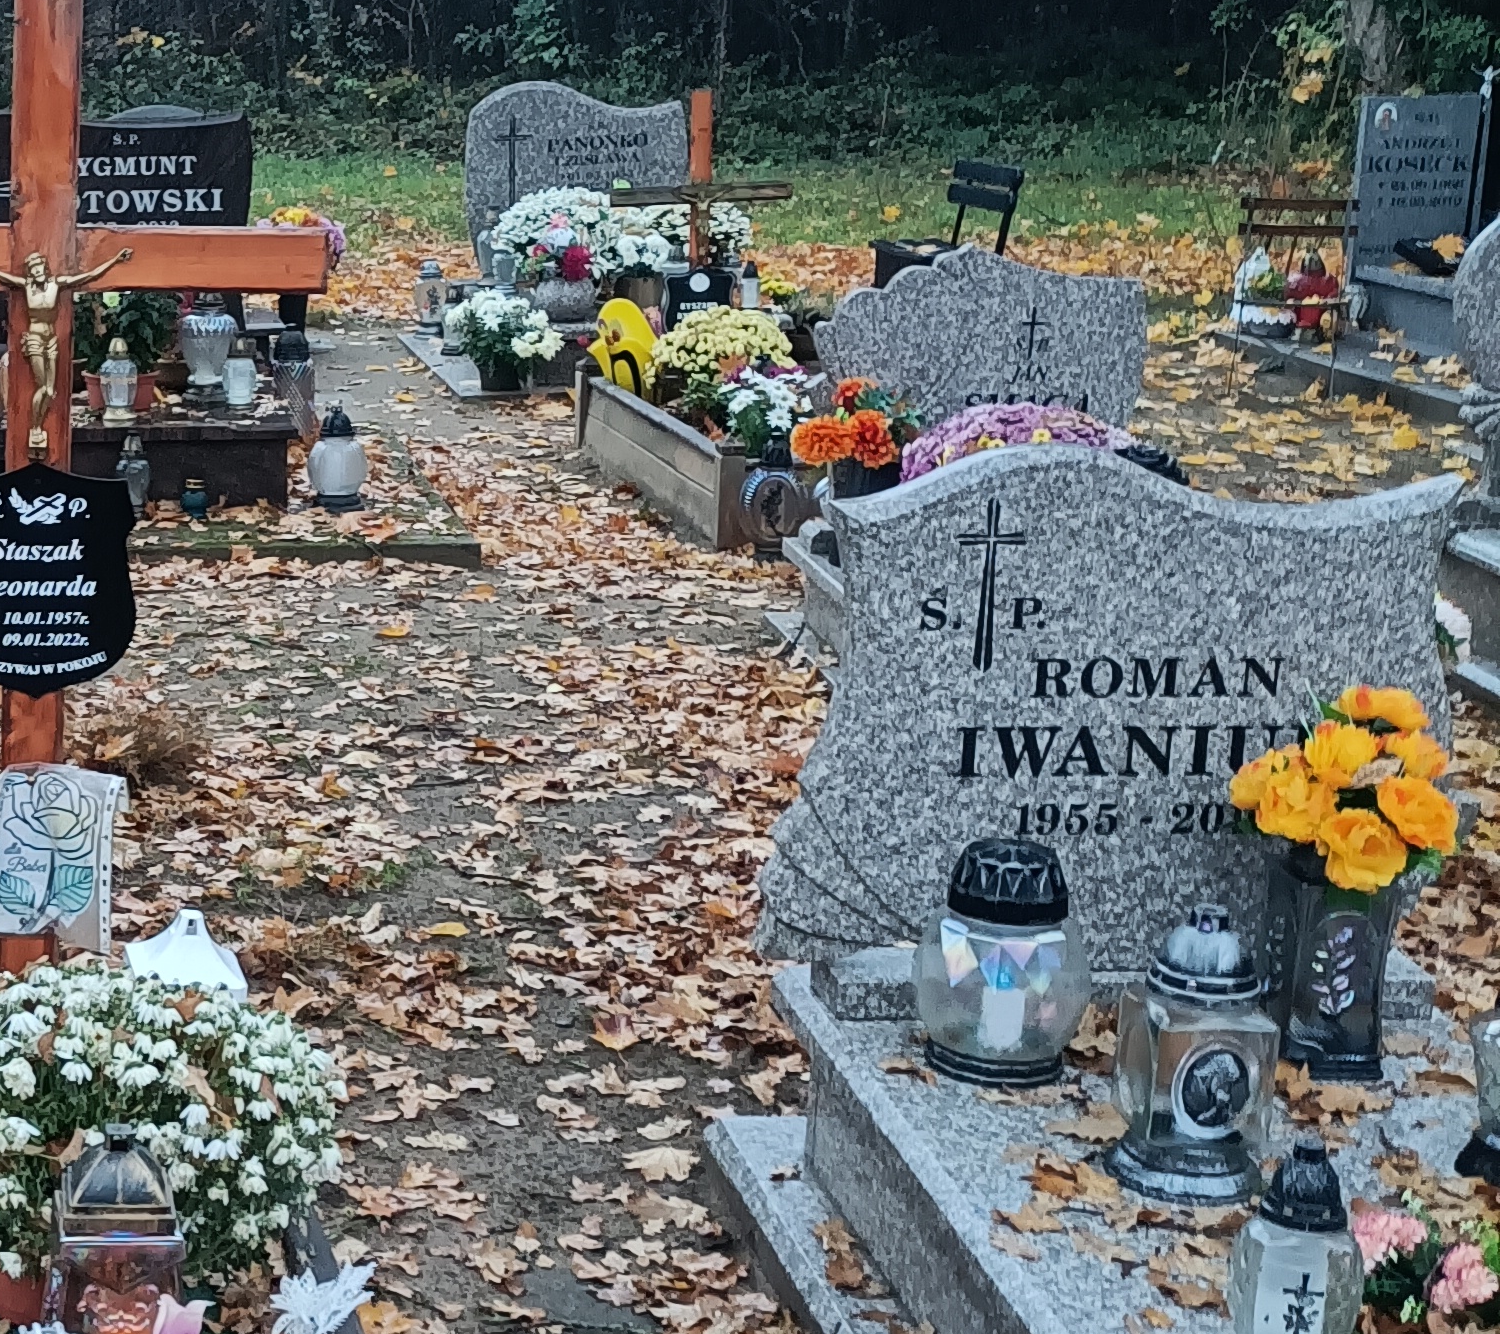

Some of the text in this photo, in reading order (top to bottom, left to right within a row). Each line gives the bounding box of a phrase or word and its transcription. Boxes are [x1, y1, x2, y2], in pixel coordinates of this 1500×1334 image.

[77, 155, 198, 177] YGMUNT
[76, 188, 224, 214] TOWSKI
[68, 497, 91, 519] P.
[2, 611, 90, 625] 10.01.1957r.
[1010, 597, 1046, 629] P.
[1, 632, 90, 647] 09.01.2022r.
[42, 664, 58, 675] W
[57, 651, 108, 674] POKOJU
[1030, 654, 1285, 698] ROMAN
[952, 724, 1312, 779] IWANIU
[1015, 803, 1118, 836] 1955
